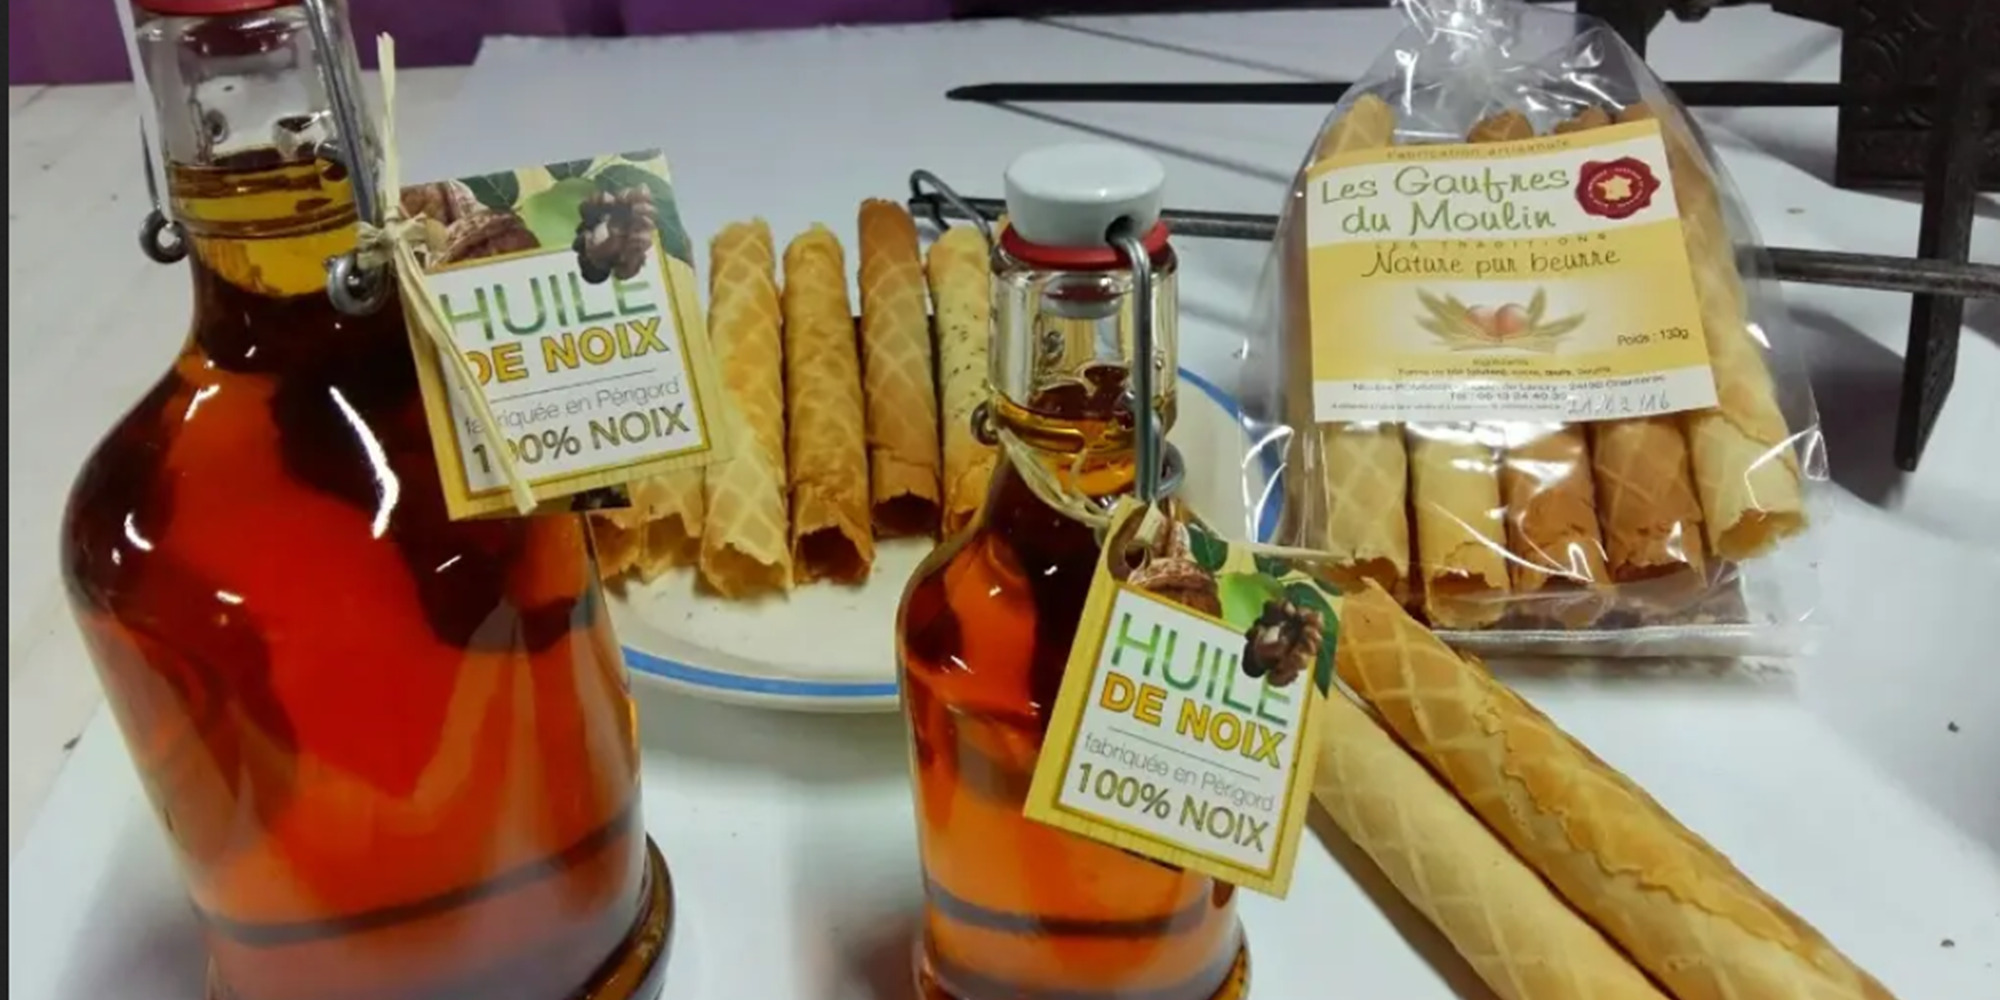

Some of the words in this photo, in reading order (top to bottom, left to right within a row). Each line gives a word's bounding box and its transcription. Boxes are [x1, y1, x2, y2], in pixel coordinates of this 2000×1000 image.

[1322, 179, 1378, 204] Les
[1394, 165, 1570, 204] Gaufres
[1342, 205, 1391, 234] du
[1409, 198, 1556, 236] Moulin
[1361, 249, 1464, 278] Nature
[1476, 257, 1517, 278] pur
[1531, 247, 1621, 273] beurre
[439, 271, 658, 341] HUILE
[540, 316, 670, 373] NOIX
[1616, 333, 1650, 346] Poids
[465, 402, 560, 435] fariquée
[565, 396, 592, 415] en
[597, 377, 681, 409] Périgord
[472, 425, 582, 474] 10%
[588, 402, 691, 451] NOIX
[1111, 612, 1291, 727] HUILE
[1099, 671, 1168, 727] DE
[1176, 698, 1287, 769] NOIX
[1084, 732, 1169, 777] fabriquée
[1173, 767, 1197, 785] en
[1201, 771, 1275, 812] Périgord
[1078, 762, 1171, 820] 100%
[1179, 794, 1269, 853] NOIX
